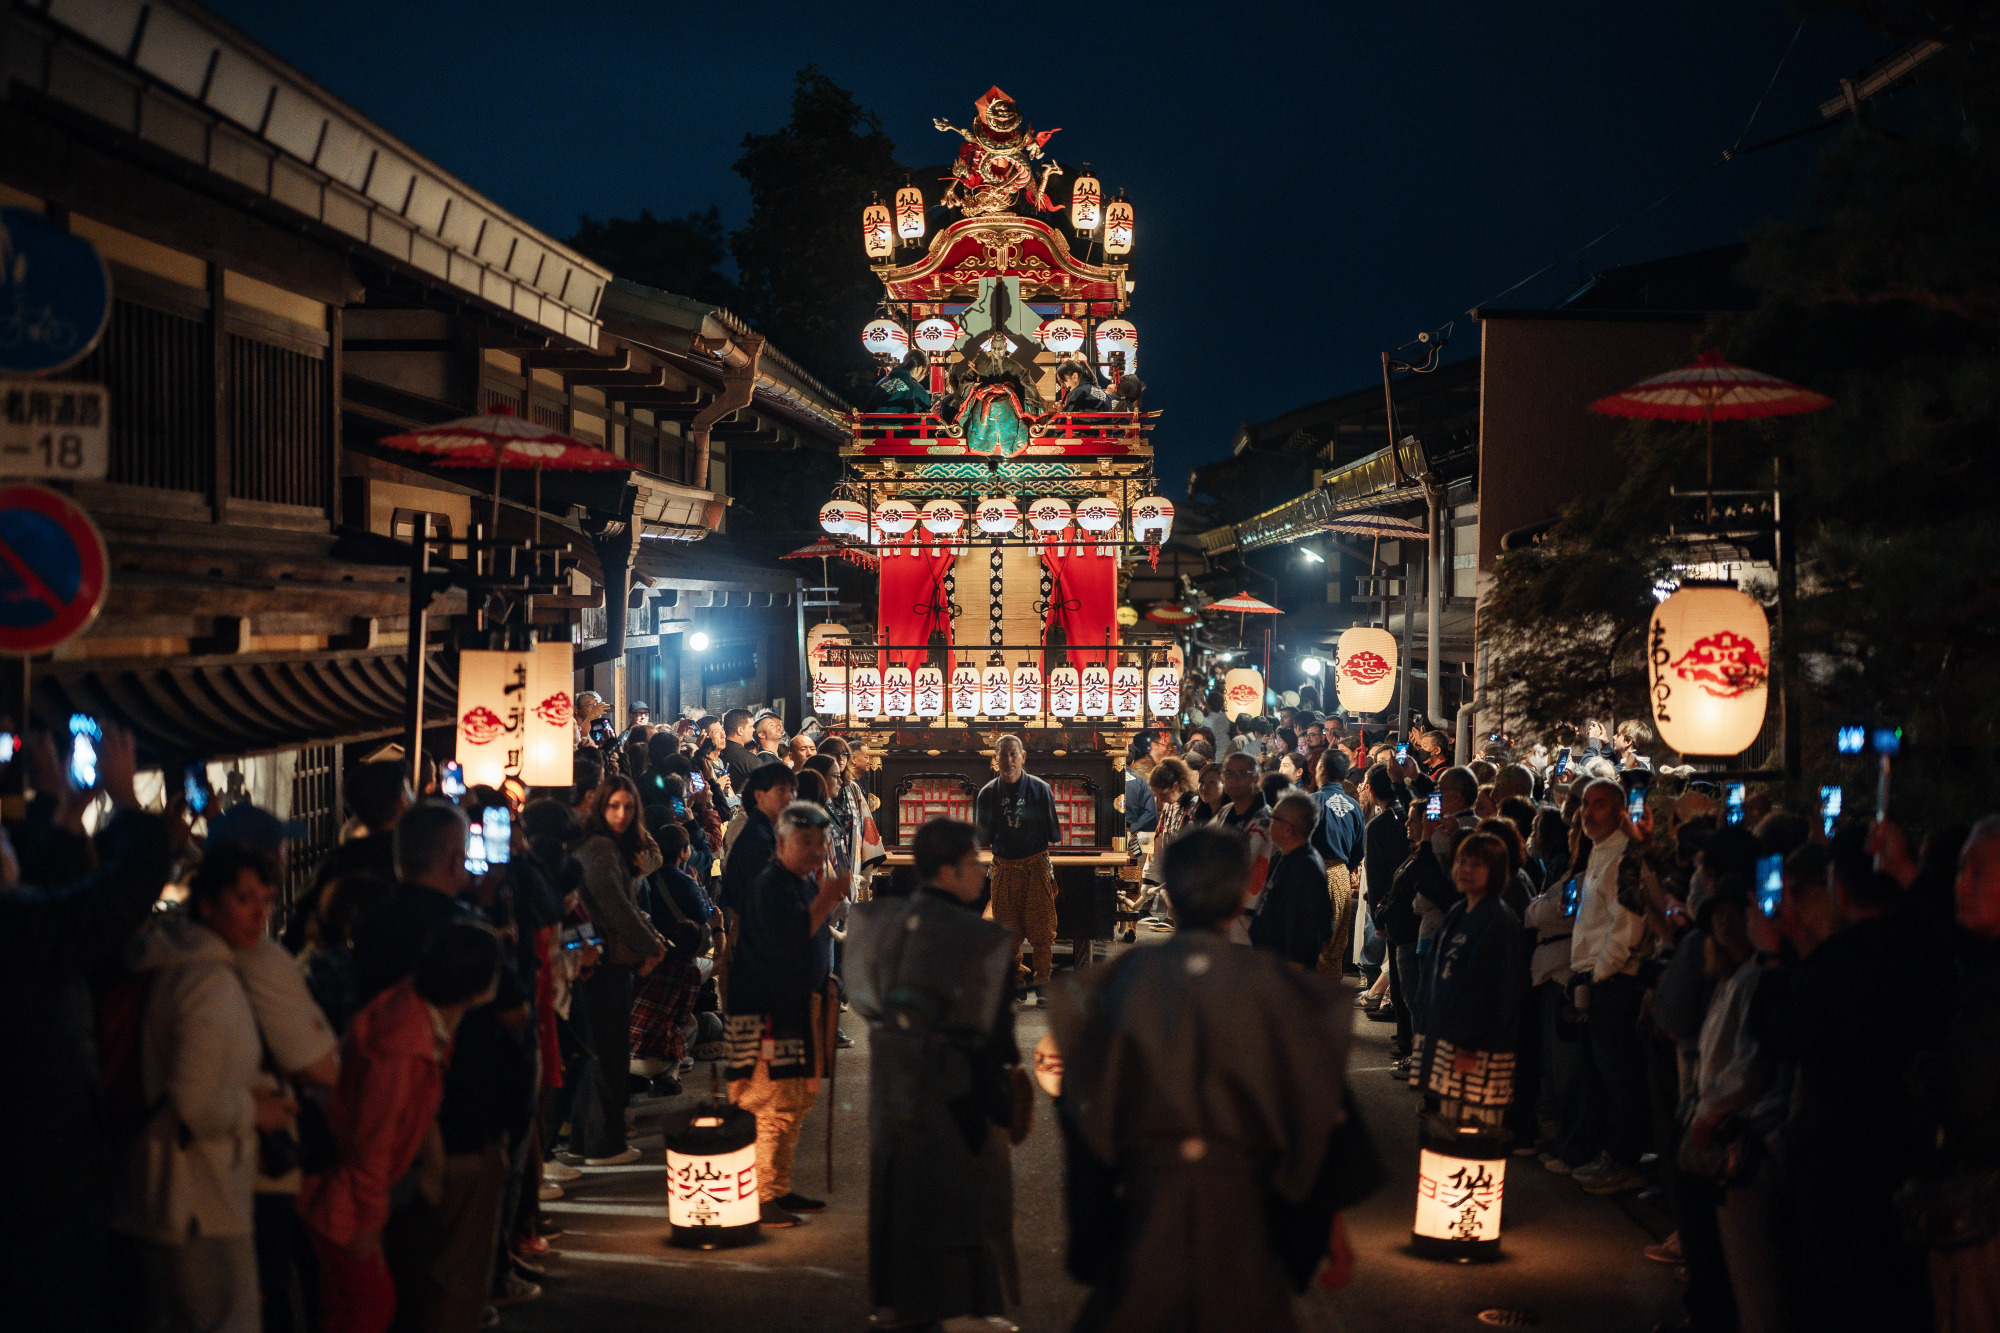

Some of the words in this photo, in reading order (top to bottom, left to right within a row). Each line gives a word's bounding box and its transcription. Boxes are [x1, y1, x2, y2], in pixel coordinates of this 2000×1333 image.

[899, 192, 920, 232] 仙人臺
[1077, 182, 1097, 222] 仙人臺
[866, 210, 886, 251] 仙人臺
[1109, 207, 1130, 248] 仙人臺
[855, 673, 876, 712] 仙人臺
[887, 673, 908, 712] 仙人臺
[918, 672, 939, 711] 仙人臺
[954, 671, 975, 710] 仙人臺
[988, 672, 1008, 710] 仙人臺
[1018, 671, 1038, 710] 仙人臺
[1053, 673, 1074, 711] 仙人臺
[1085, 671, 1105, 710] 仙人臺
[1118, 674, 1138, 712] 仙人臺
[1158, 673, 1177, 711] 仙人臺
[681, 1162, 728, 1226] 仙人臺
[1447, 1164, 1493, 1241] 仙人臺
